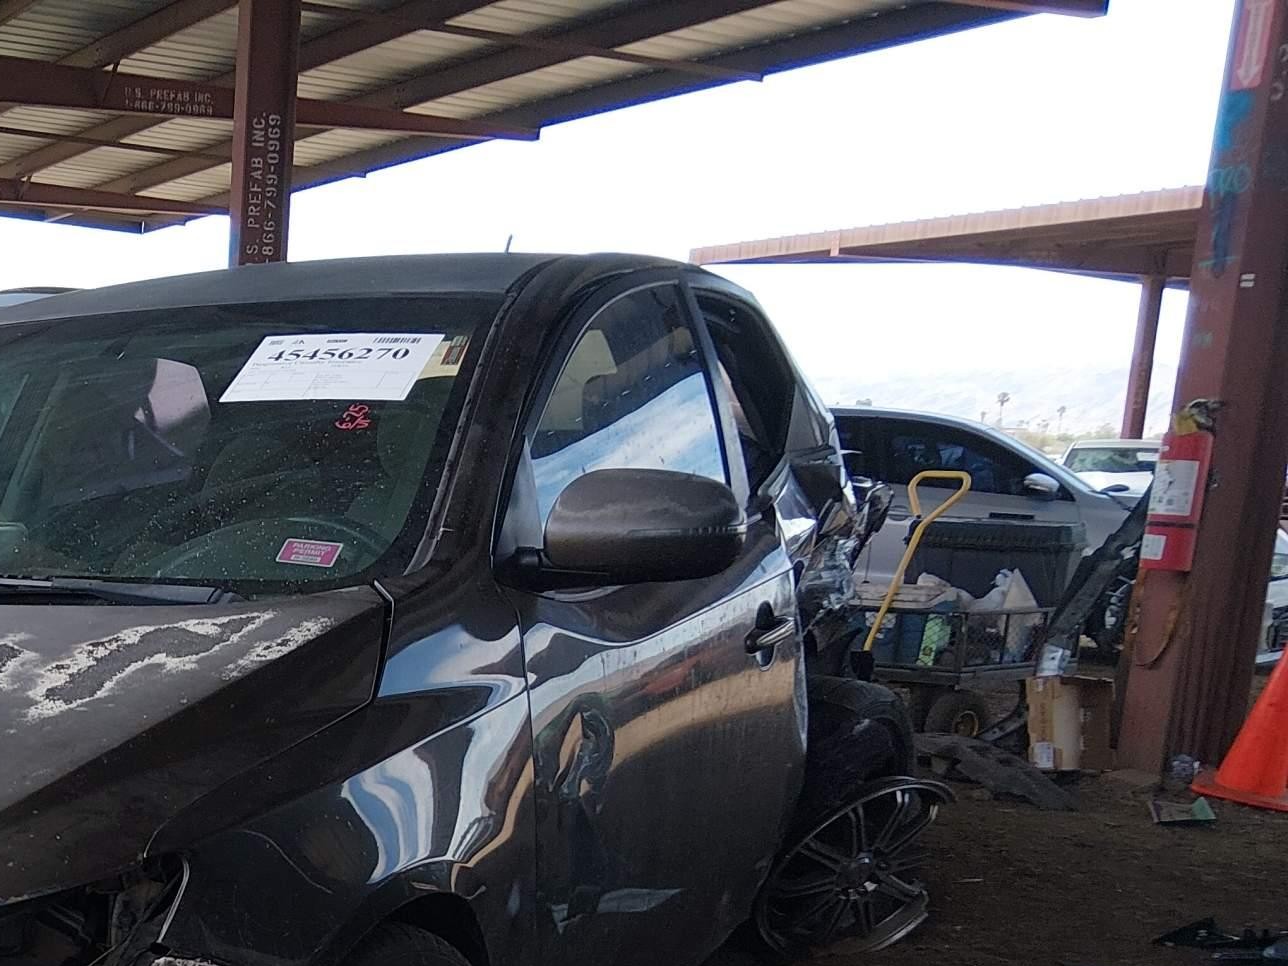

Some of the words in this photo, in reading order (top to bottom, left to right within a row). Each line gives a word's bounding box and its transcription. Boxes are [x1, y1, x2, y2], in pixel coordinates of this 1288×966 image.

[150, 88, 191, 103] PREFAB
[251, 111, 267, 148] INC.
[247, 157, 263, 229] PREFAB
[267, 347, 411, 362] 45456270
